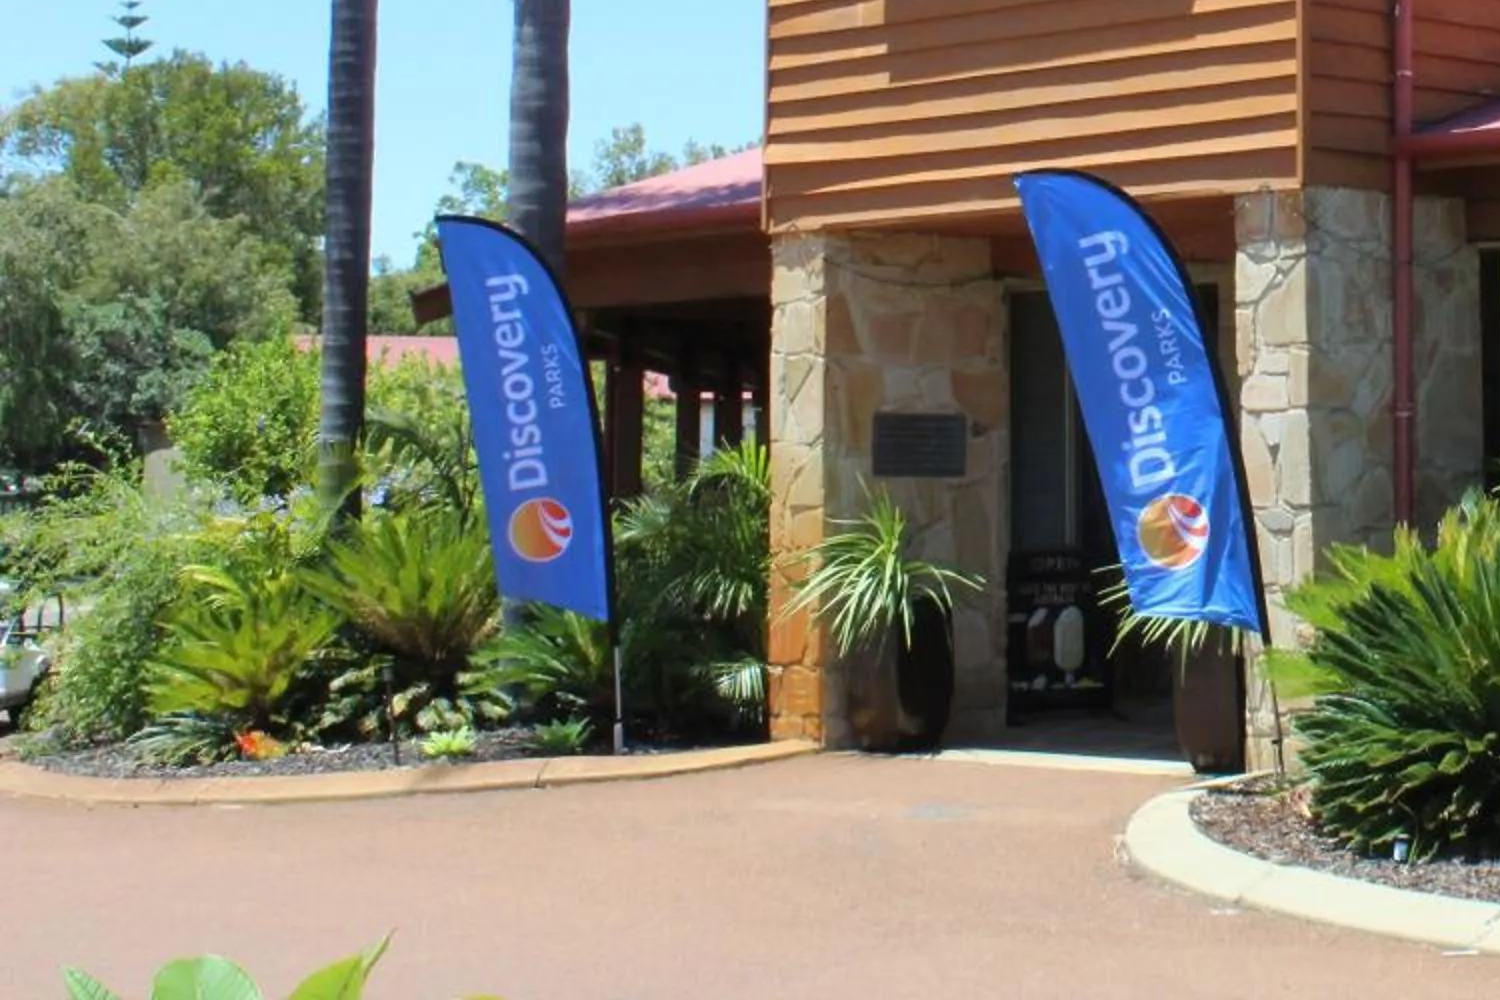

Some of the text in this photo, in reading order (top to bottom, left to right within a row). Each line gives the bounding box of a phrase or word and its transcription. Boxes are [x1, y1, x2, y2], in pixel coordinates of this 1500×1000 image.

[486, 272, 547, 490] Discovery
[541, 344, 563, 409] PARKS
[1079, 230, 1176, 490] Discovery
[1152, 308, 1185, 385] PARKS
